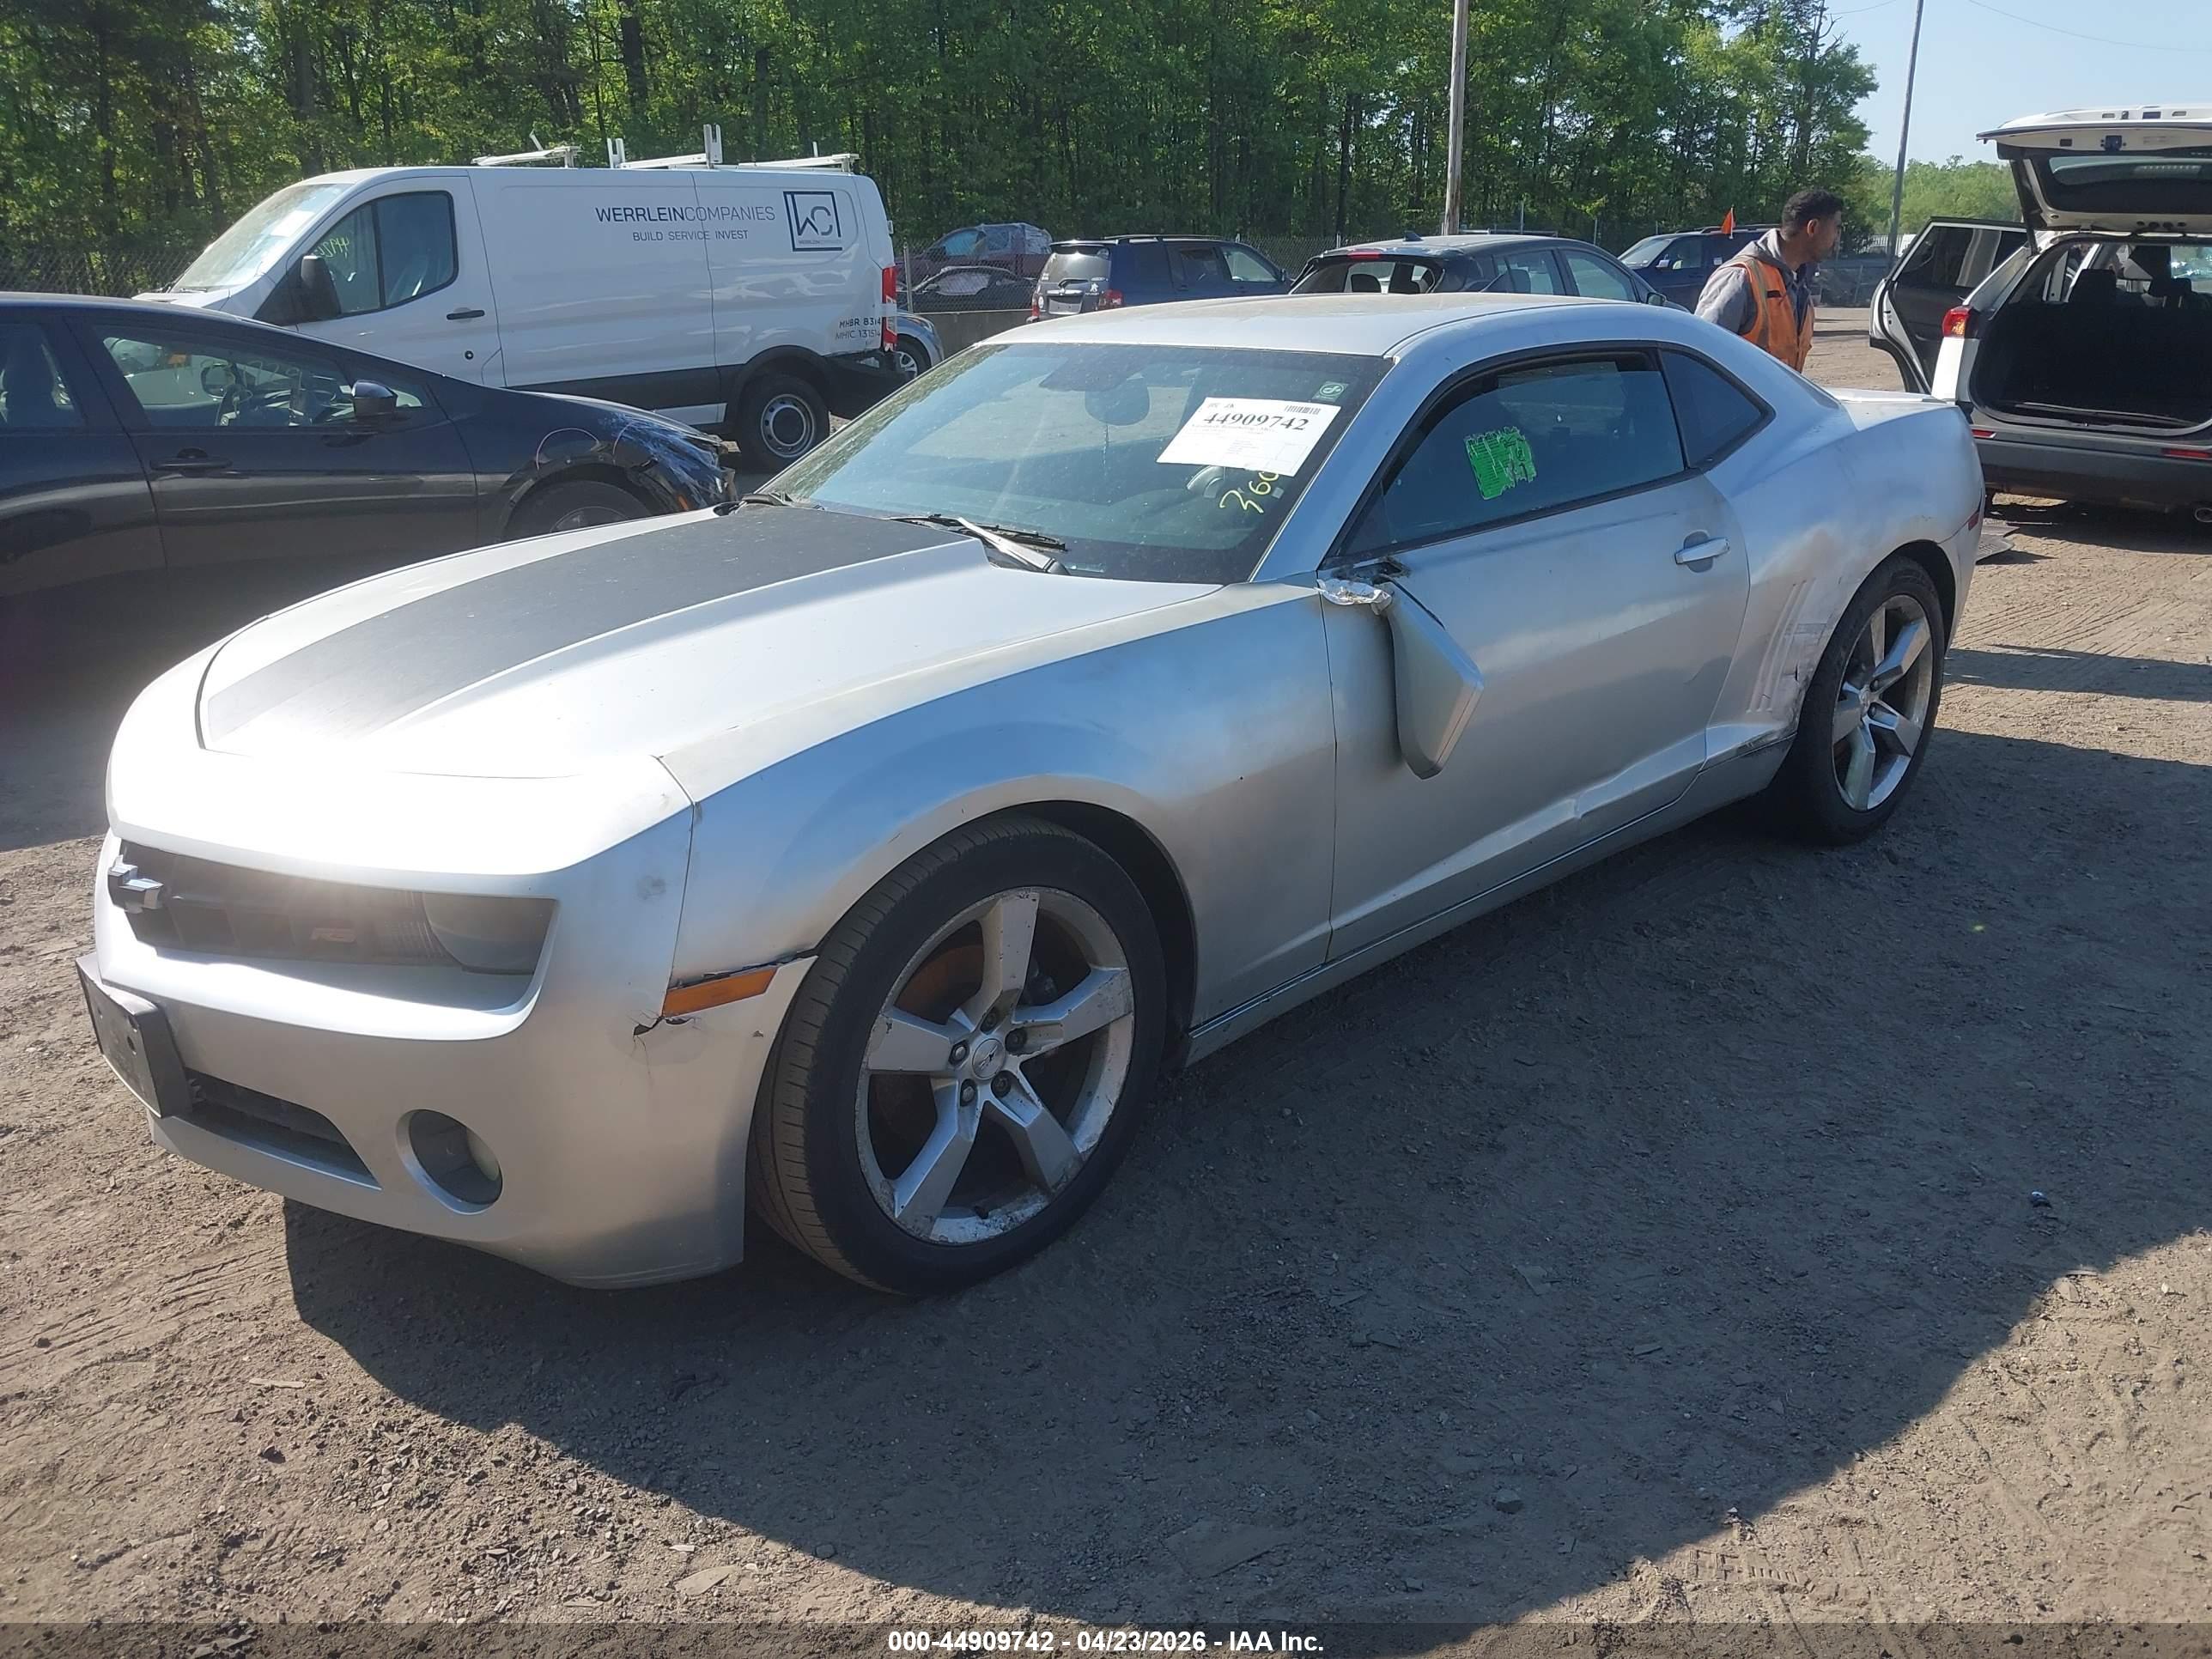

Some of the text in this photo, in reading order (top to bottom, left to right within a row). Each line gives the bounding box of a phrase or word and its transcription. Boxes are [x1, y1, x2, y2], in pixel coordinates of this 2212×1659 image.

[595, 206, 776, 222] WERRLEINCOMPANIES
[632, 229, 749, 241] BUILD SERVICE INVEST
[1204, 412, 1310, 431] 44909742
